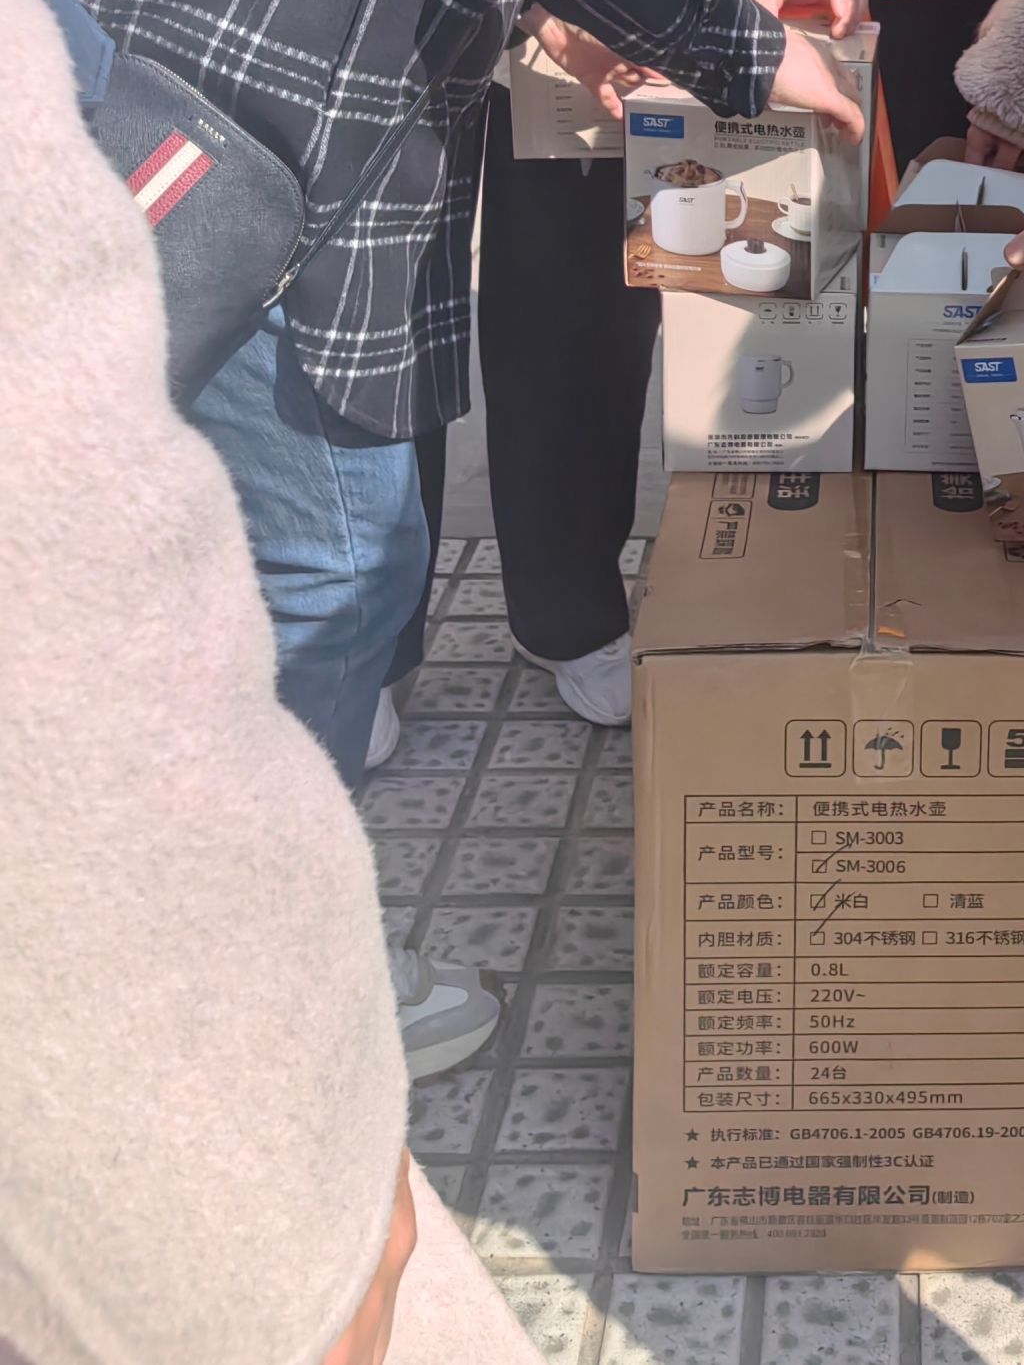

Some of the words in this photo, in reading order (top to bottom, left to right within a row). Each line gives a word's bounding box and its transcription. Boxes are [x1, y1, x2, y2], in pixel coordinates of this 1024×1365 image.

[643, 117, 672, 128] SAST
[714, 121, 805, 138] 便携式电热水壶
[943, 305, 983, 319] SAST
[974, 361, 1004, 373] SAST
[699, 801, 784, 818] 产品名称：
[812, 800, 947, 818] 便携式电热水壶
[835, 830, 904, 846] SM-3003
[698, 845, 784, 862] 产品型号：
[835, 859, 906, 874] SM-3006
[698, 894, 783, 910] 产品颜色：
[835, 892, 869, 909] 米白
[950, 893, 985, 909] 清蓝
[698, 931, 783, 947] 内胆材质：
[833, 929, 916, 946] 304不锈钢
[698, 962, 782, 978] 额定容量：
[810, 962, 848, 977] 0.8L
[698, 988, 782, 1005] 额定电压：
[698, 1014, 782, 1030] 额定频率：
[809, 1014, 856, 1029] 50Hz
[698, 1040, 781, 1056] 额定功率：
[809, 1040, 859, 1055] 600W
[697, 1066, 781, 1082] 产品数量：
[810, 1065, 847, 1081] 24台
[697, 1091, 781, 1107] 包装尺寸：
[808, 1090, 963, 1106] 665x330x495mm
[710, 1154, 935, 1170] 本产品已通过国家强制性3C认证
